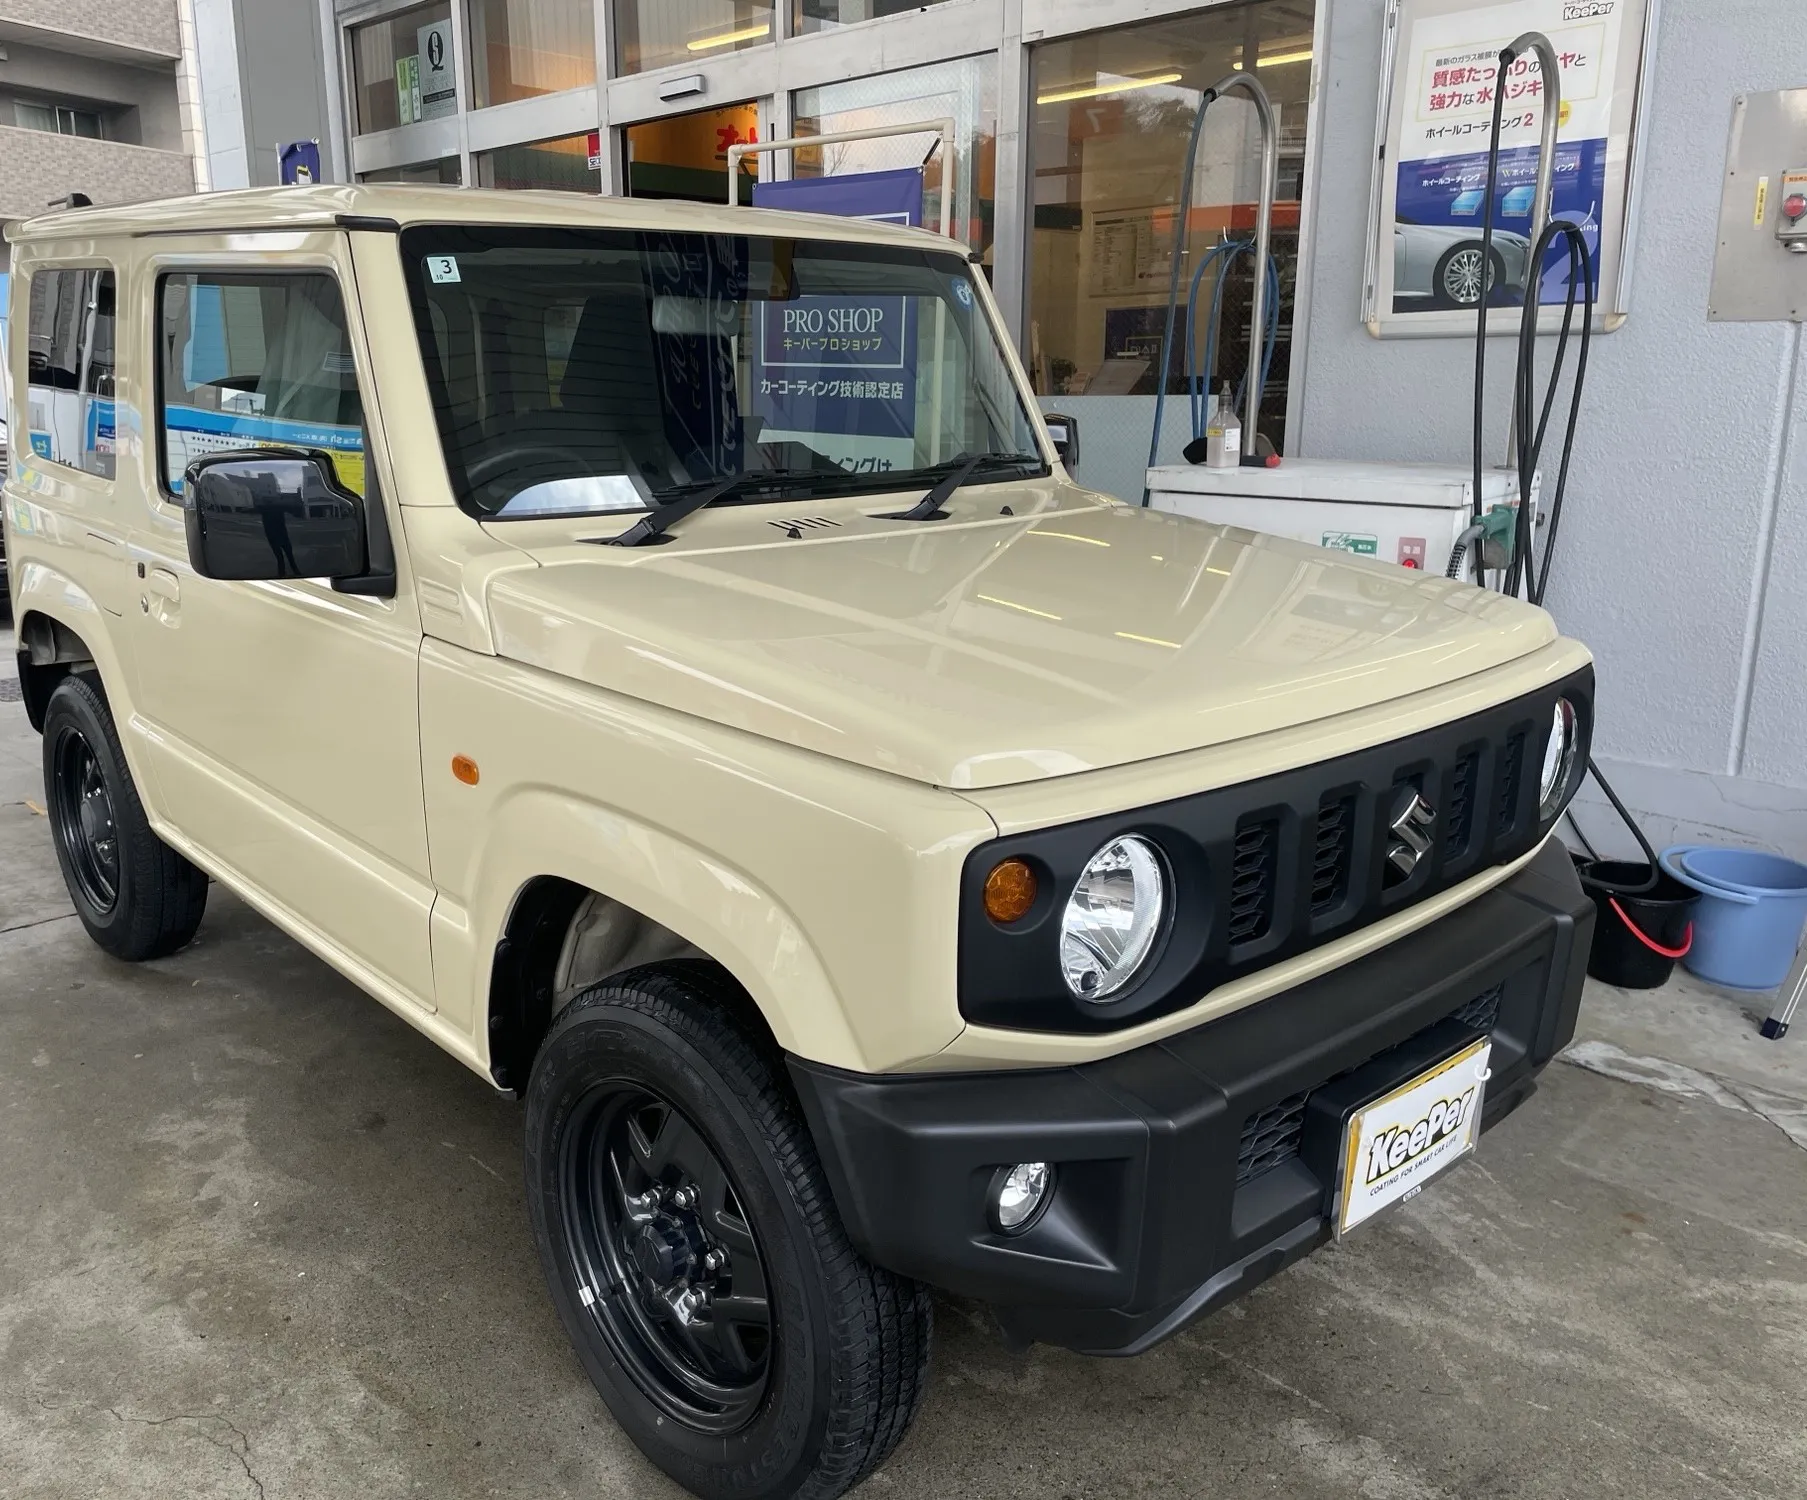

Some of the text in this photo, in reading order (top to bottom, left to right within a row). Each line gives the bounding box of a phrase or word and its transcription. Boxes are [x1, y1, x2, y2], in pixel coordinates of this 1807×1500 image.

[1563, 2, 1614, 20] KeePer
[1432, 52, 1586, 89] 質感たっりのヤと
[440, 259, 452, 274] 3
[783, 307, 884, 333] PRO SHOP
[760, 379, 904, 400] カーコーティング技術認定店
[1366, 1086, 1475, 1185] KeePer
[1369, 1174, 1399, 1196] COATING
[1400, 1165, 1413, 1179] FOR
[1414, 1152, 1433, 1170] SMART
[1434, 1143, 1445, 1156] CAR
[1446, 1134, 1458, 1149] LIFE
